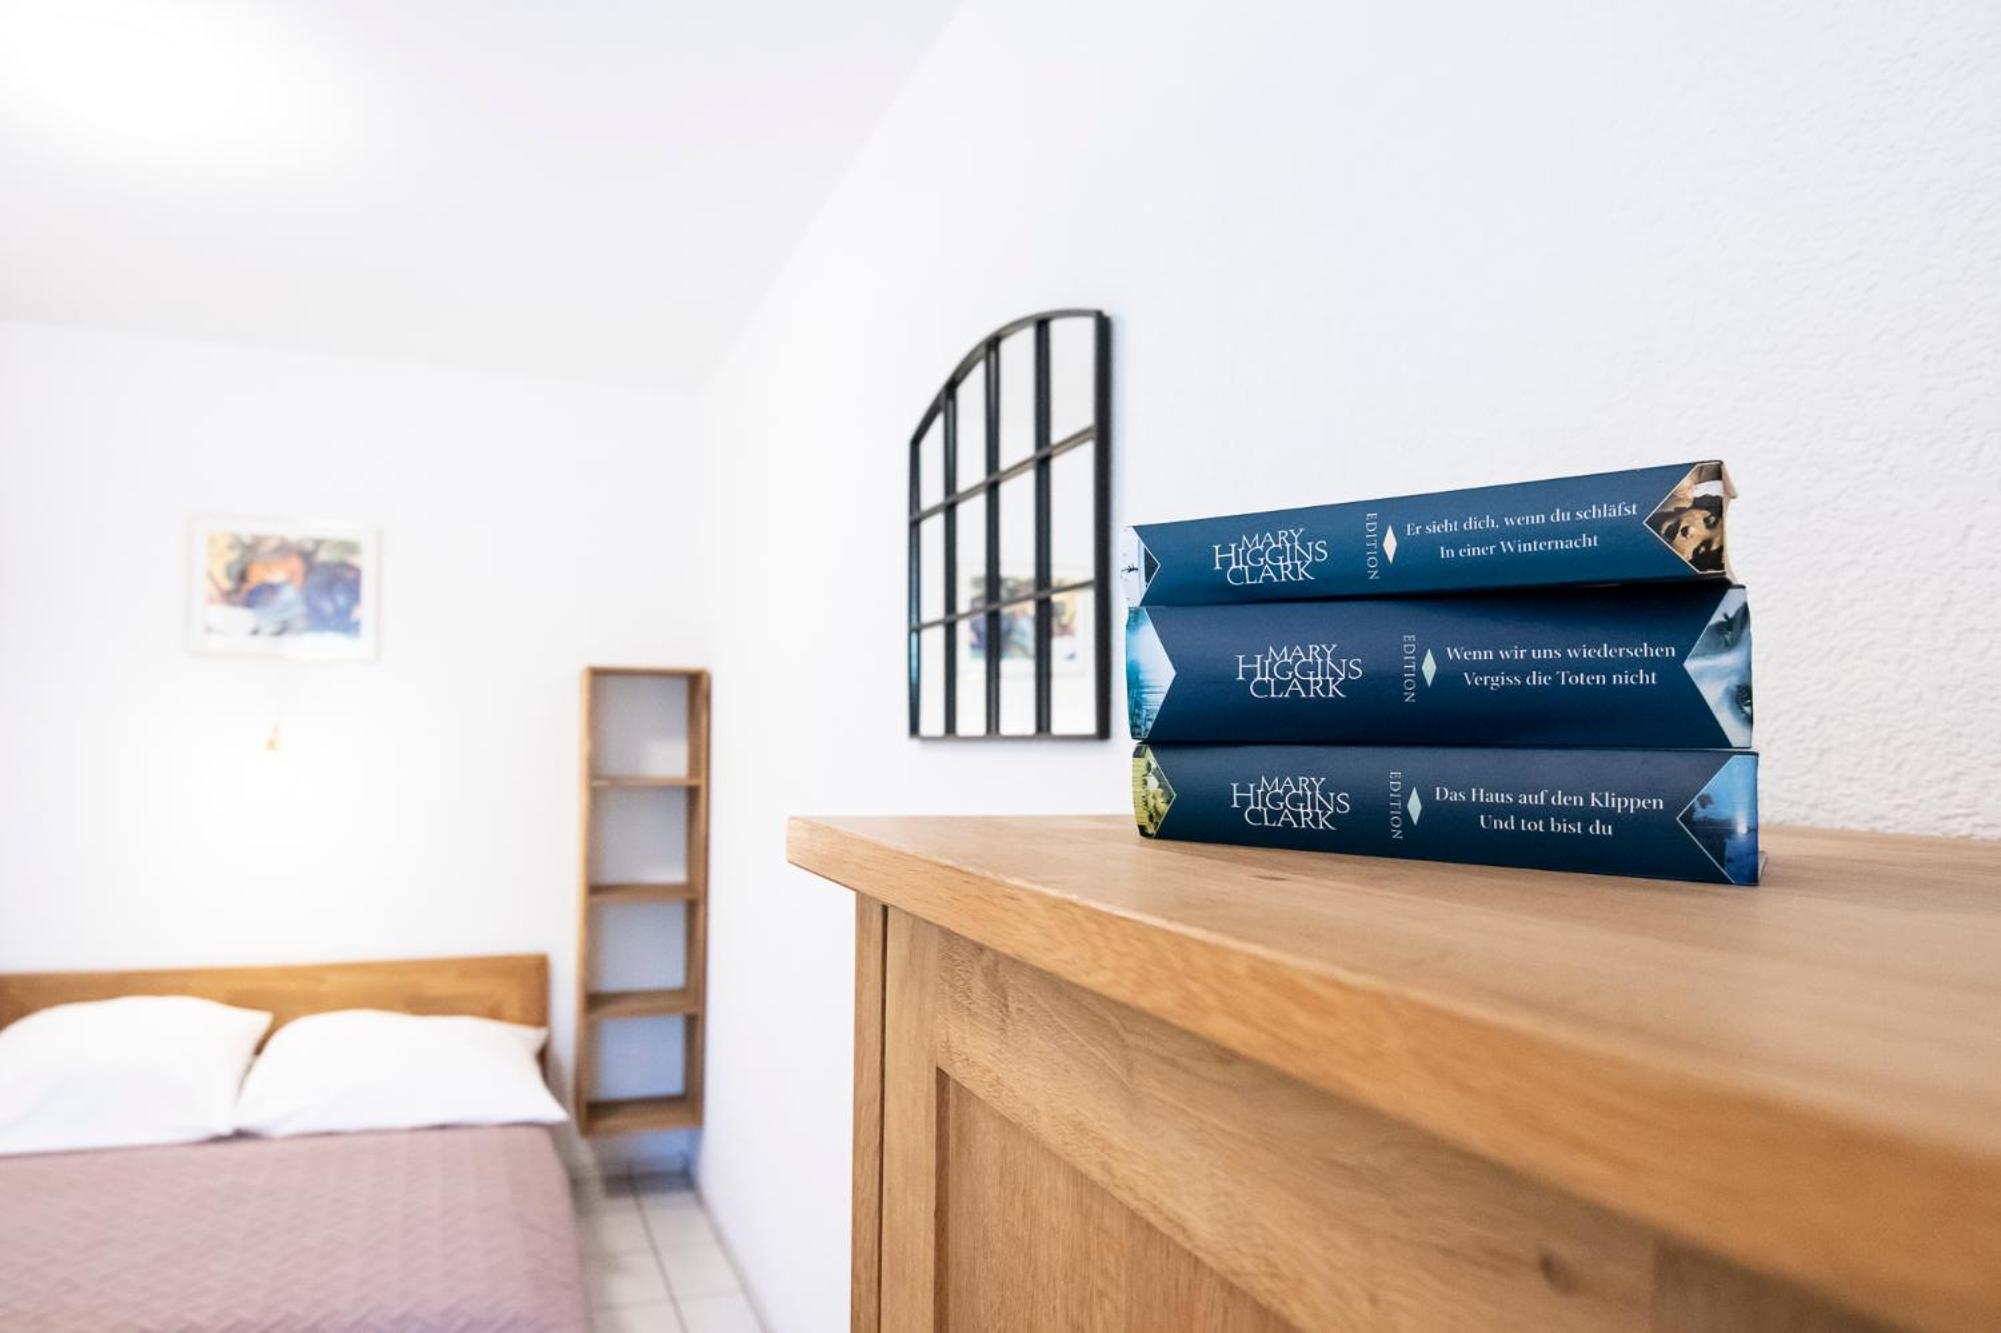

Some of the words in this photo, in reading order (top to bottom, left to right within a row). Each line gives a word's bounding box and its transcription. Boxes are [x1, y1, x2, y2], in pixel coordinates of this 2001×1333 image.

[1406, 523, 1424, 536] Er
[1427, 518, 1458, 535] sieht
[1504, 512, 1546, 525] wenn
[1551, 508, 1571, 522] du
[1576, 502, 1638, 520] schläfst
[1242, 529, 1305, 550] MARY
[1366, 513, 1379, 580] EDITION
[1440, 545, 1454, 559] In
[1459, 542, 1496, 558] einer
[1500, 535, 1598, 553] Winternacht
[1212, 541, 1328, 570] HIGGINS
[1227, 561, 1314, 586] CLARK
[1268, 644, 1339, 661] MARY
[1447, 647, 1493, 660] Wenn
[1500, 646, 1526, 659] wir
[1531, 647, 1561, 658] uns
[1567, 644, 1675, 658] wiedersehen
[1236, 655, 1362, 681] HIGGINS
[1404, 635, 1415, 703] EDITION
[1464, 672, 1521, 689] Vergiss
[1526, 671, 1551, 685] die
[1556, 671, 1606, 685] Toten
[1612, 671, 1656, 684] nicht
[1250, 677, 1346, 698] CLARK
[1261, 775, 1326, 793] MARY
[1230, 783, 1350, 814] HIGGINS
[1390, 771, 1402, 839] EDITION
[1435, 786, 1465, 801] Das
[1471, 789, 1513, 804] Haus
[1519, 790, 1548, 805] auf
[1552, 791, 1584, 806] den
[1589, 792, 1663, 813] Klippen
[1244, 808, 1336, 830] CLARK
[1480, 815, 1515, 831] Und
[1521, 817, 1545, 832] tot
[1550, 818, 1583, 833] bist
[1589, 820, 1612, 836] du
